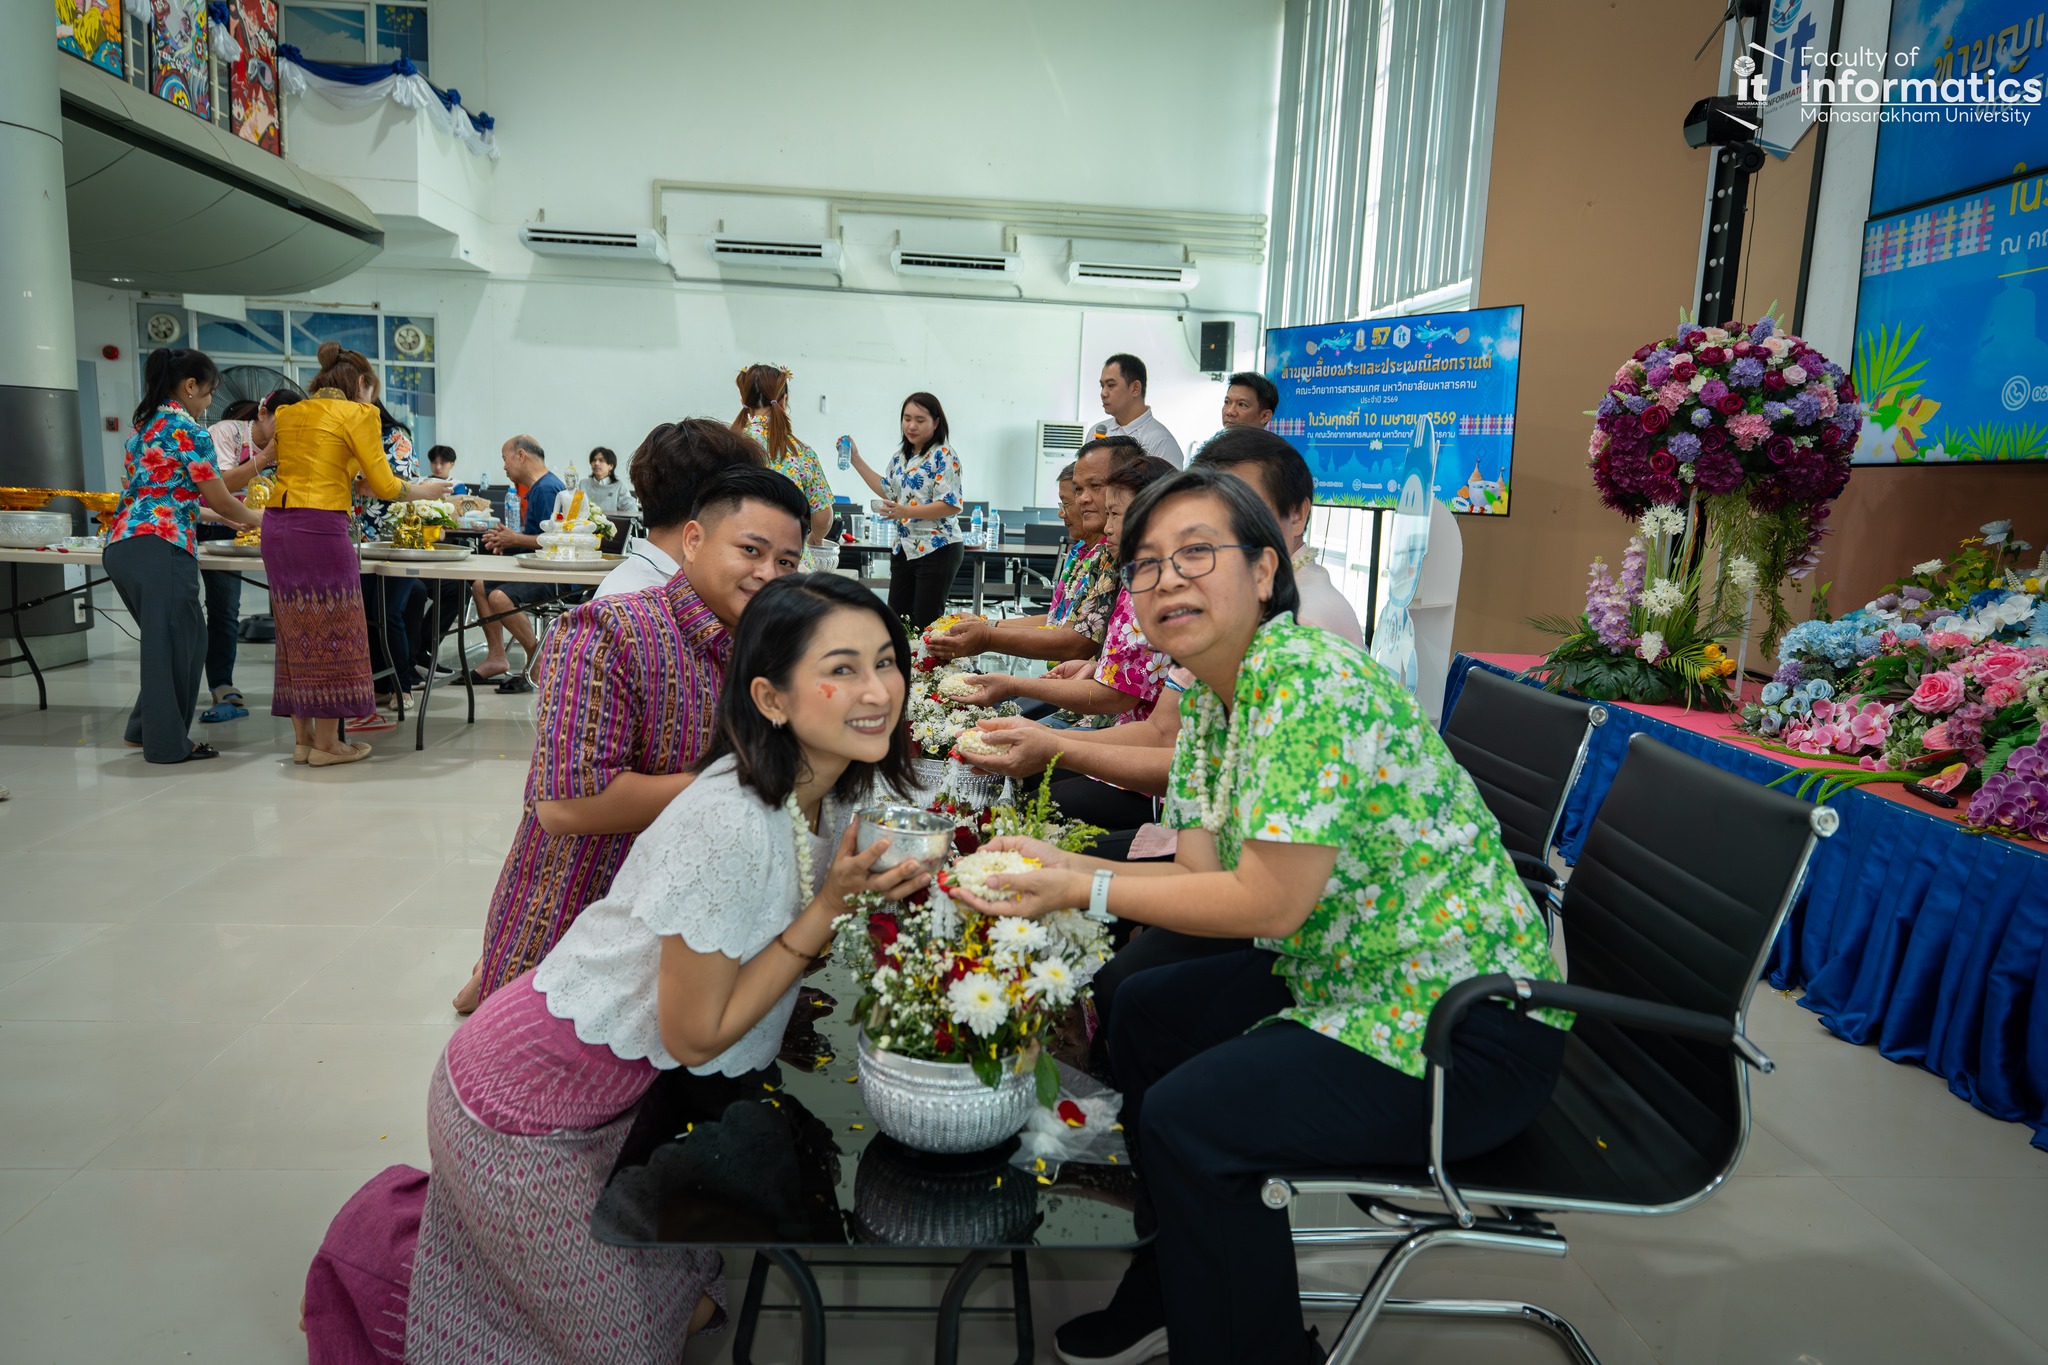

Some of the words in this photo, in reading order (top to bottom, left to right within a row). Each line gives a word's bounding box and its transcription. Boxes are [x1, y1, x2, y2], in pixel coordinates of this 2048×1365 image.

[1933, 13, 2048, 88] ทำบุญเ
[1766, 82, 1810, 108] INFORMATIS
[2009, 161, 2048, 216] ใน
[1371, 326, 1391, 345] 57
[1295, 383, 1380, 396] คณะวิทยาการสารสนเทศ
[1382, 379, 1477, 392] มหาวิทยาลัยมหาสารคาม
[1364, 413, 1377, 426] 10
